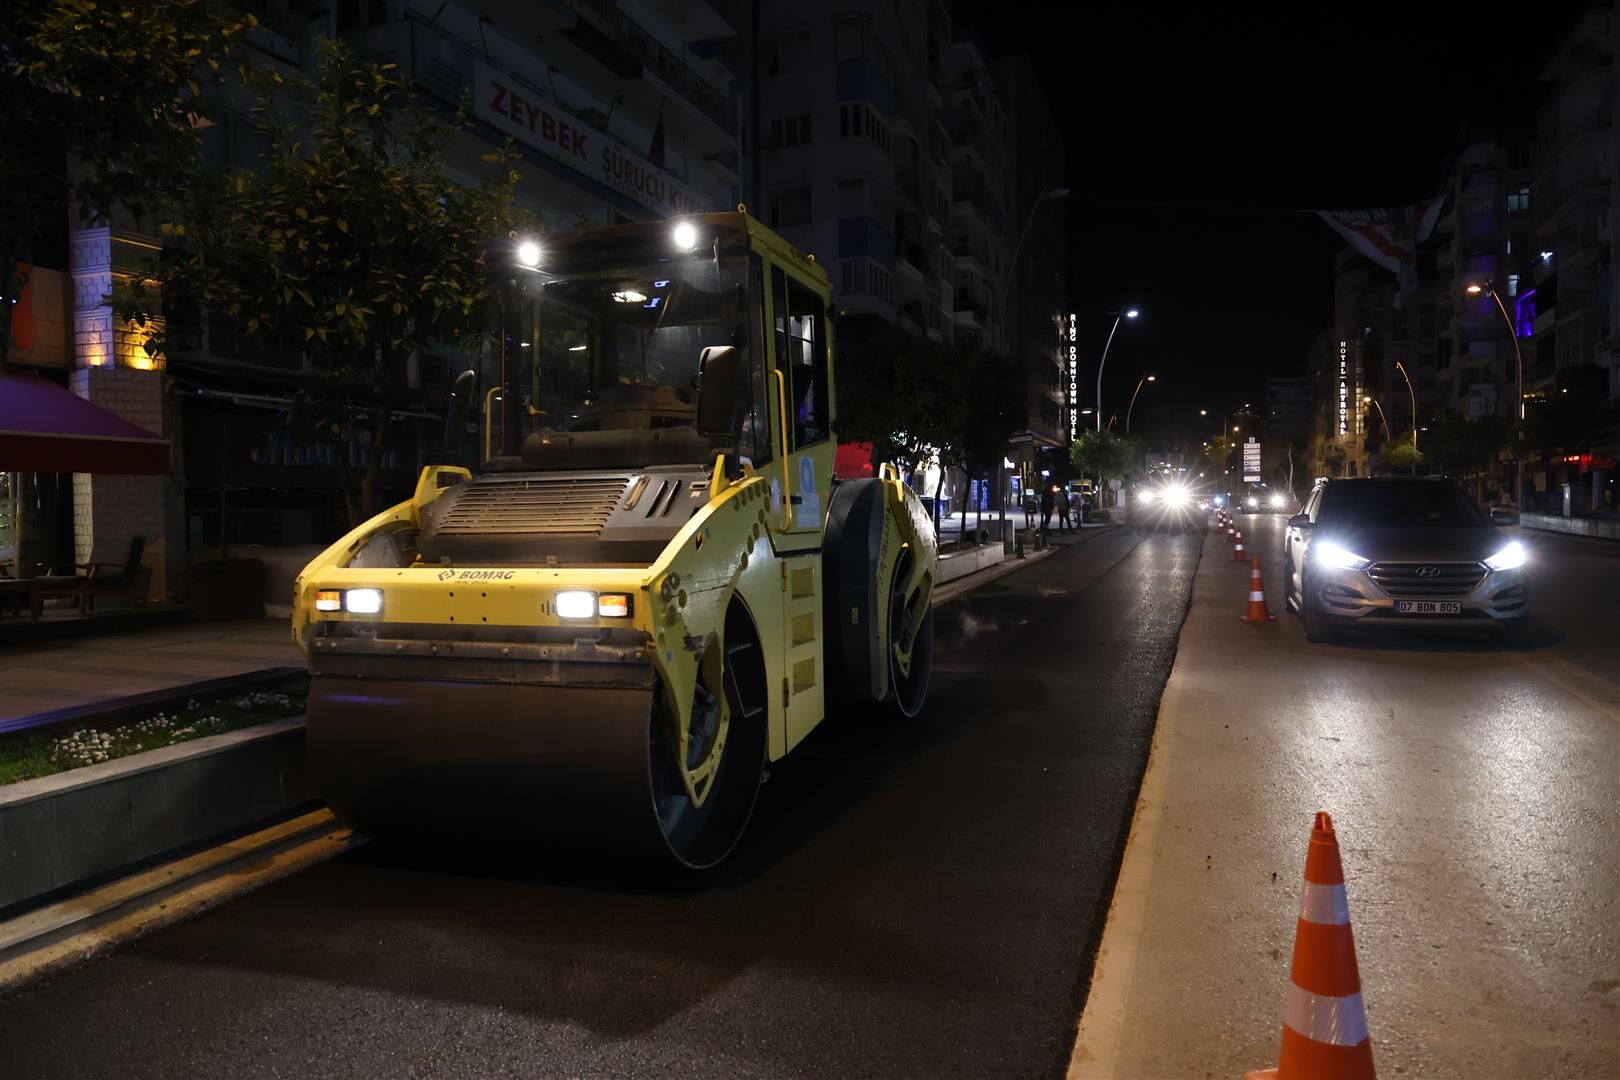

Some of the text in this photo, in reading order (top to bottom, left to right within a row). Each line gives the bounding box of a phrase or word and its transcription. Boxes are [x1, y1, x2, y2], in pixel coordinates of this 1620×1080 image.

[490, 80, 588, 161] ZEYBEK
[458, 570, 516, 580] BOMAG
[1400, 602, 1412, 612] 07
[1440, 602, 1458, 612] 805
